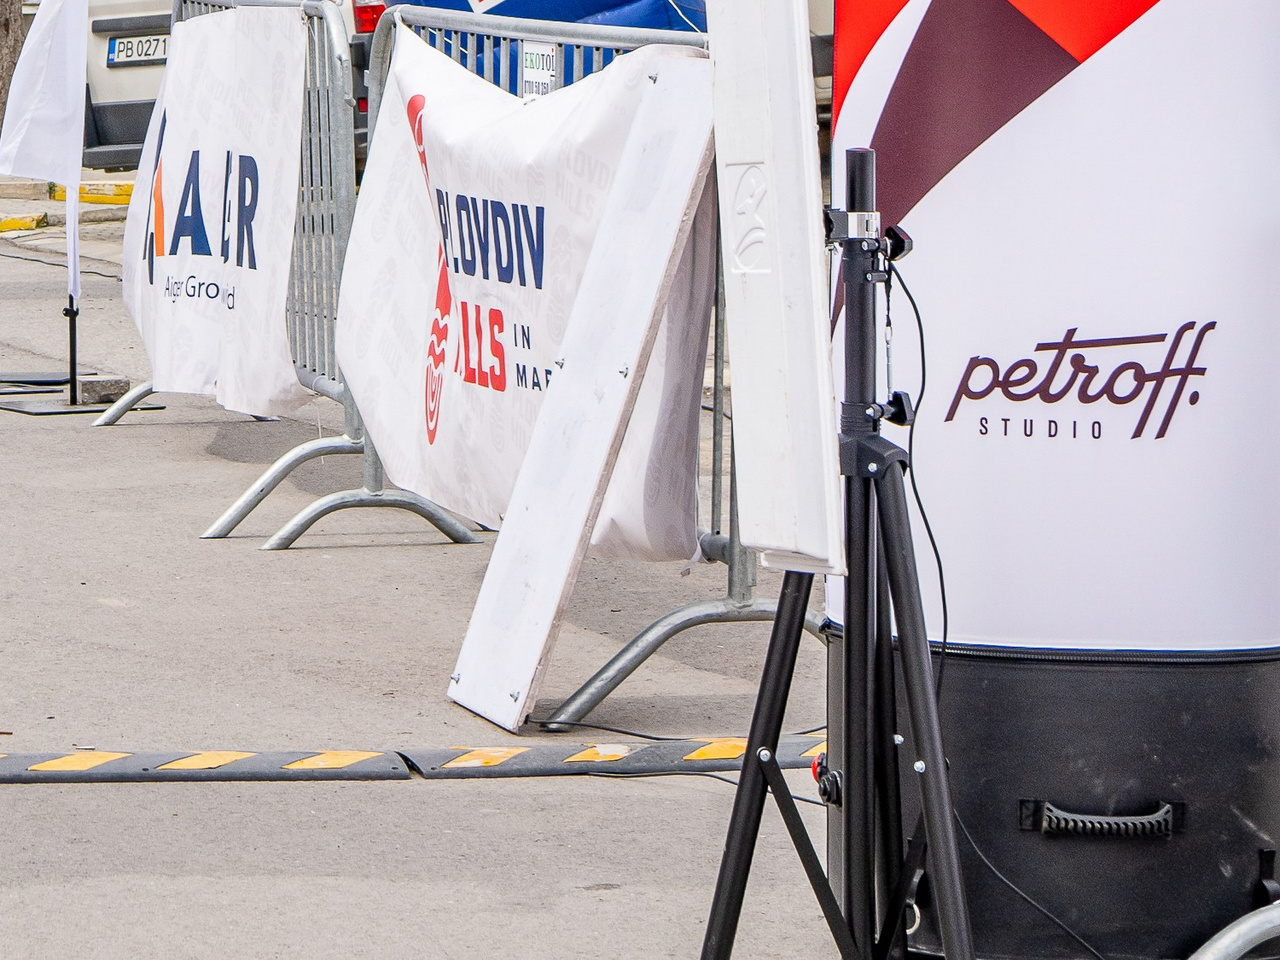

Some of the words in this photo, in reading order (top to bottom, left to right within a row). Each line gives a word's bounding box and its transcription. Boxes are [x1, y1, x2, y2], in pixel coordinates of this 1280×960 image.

[116, 40, 134, 59] PB
[136, 38, 167, 57] 0271
[513, 323, 531, 350] IN
[979, 416, 1102, 440] STUDIO
